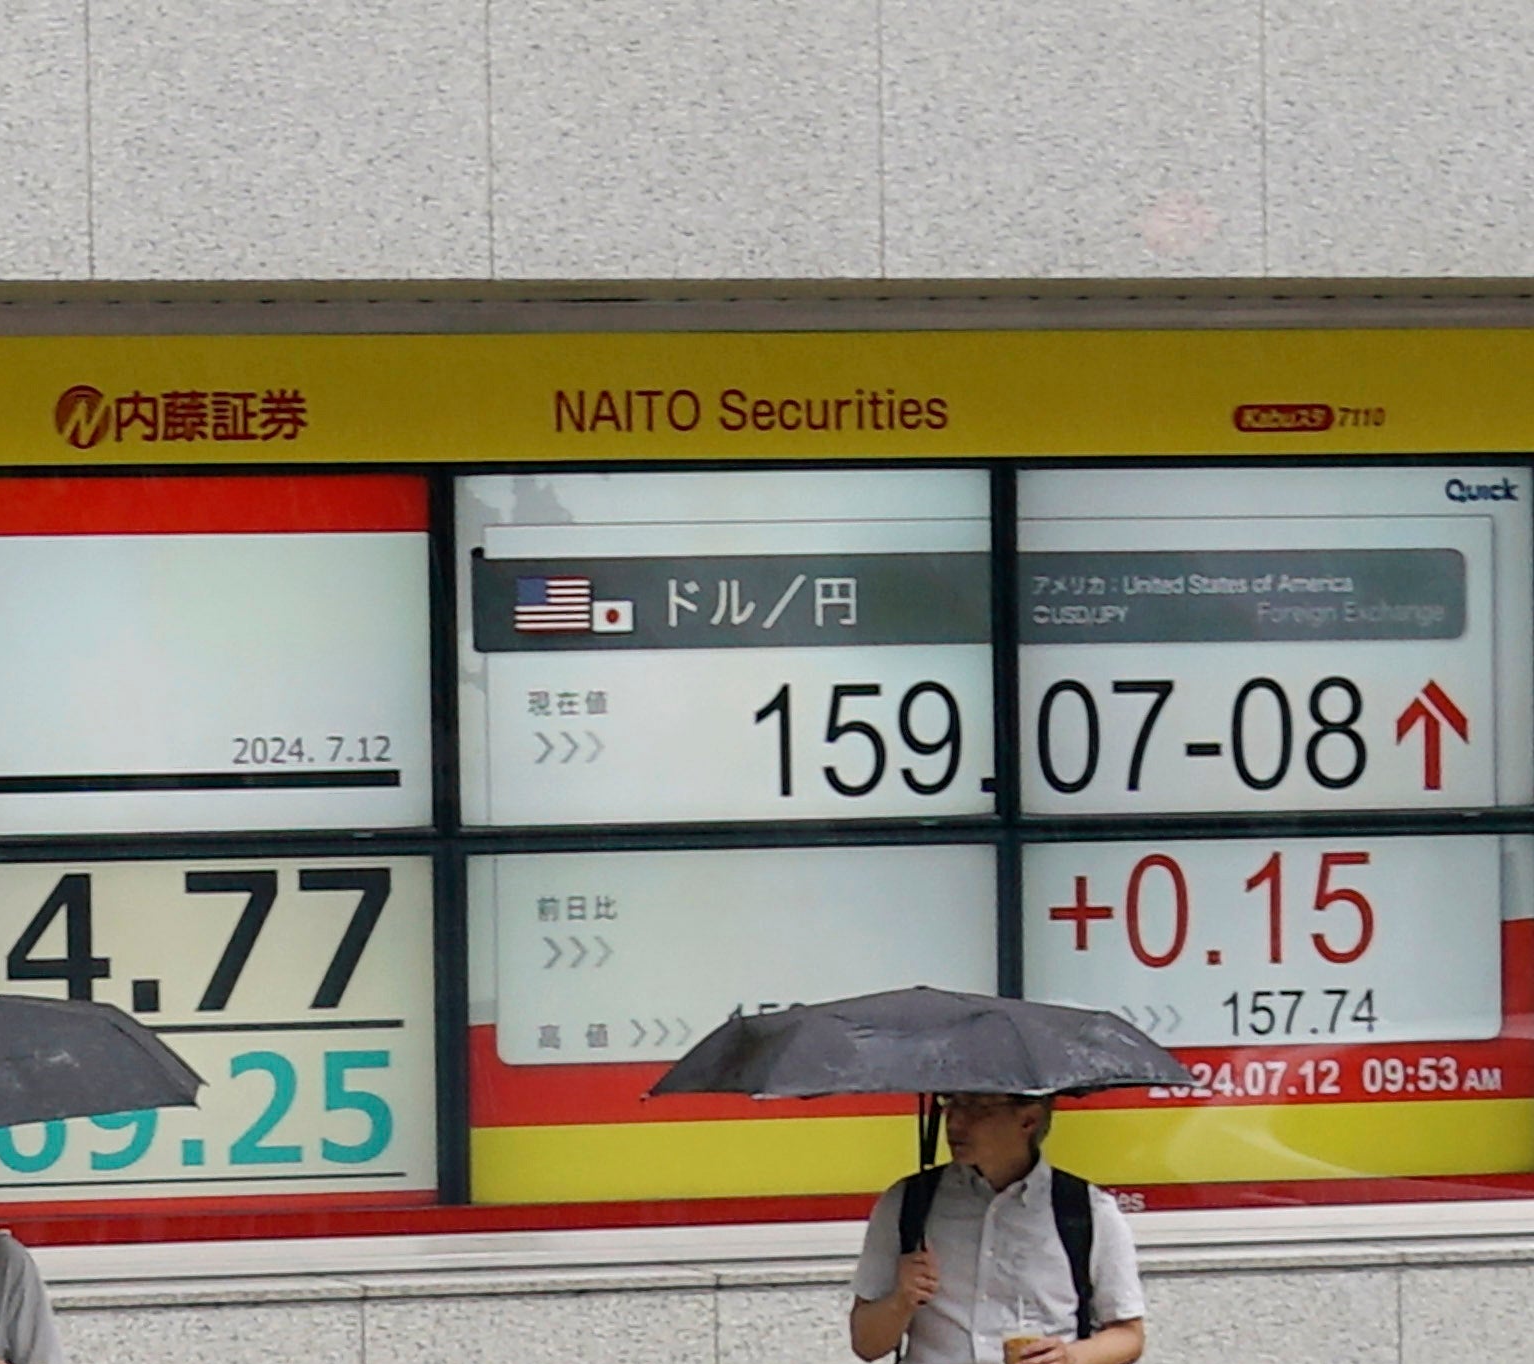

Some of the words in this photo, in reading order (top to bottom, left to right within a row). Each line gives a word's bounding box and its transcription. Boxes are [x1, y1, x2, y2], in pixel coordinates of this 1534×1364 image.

[114, 389, 309, 443] 内藤証券
[554, 389, 702, 433] NAITO
[719, 388, 949, 432] Securities
[1123, 574, 1185, 596] United
[1187, 574, 1250, 595] States
[1251, 573, 1273, 594] of
[1277, 574, 1354, 594] America
[1256, 600, 1338, 628] Foreign
[1344, 599, 1446, 626] Exchange
[527, 690, 608, 717] 現在値
[536, 895, 619, 923] 前日比
[1048, 850, 1375, 970] +0.15
[1222, 989, 1379, 1038] 157.74
[1149, 1057, 1342, 1098] 24.07.12
[1362, 1056, 1460, 1095] 09:53
[1462, 1067, 1503, 1093] AM
